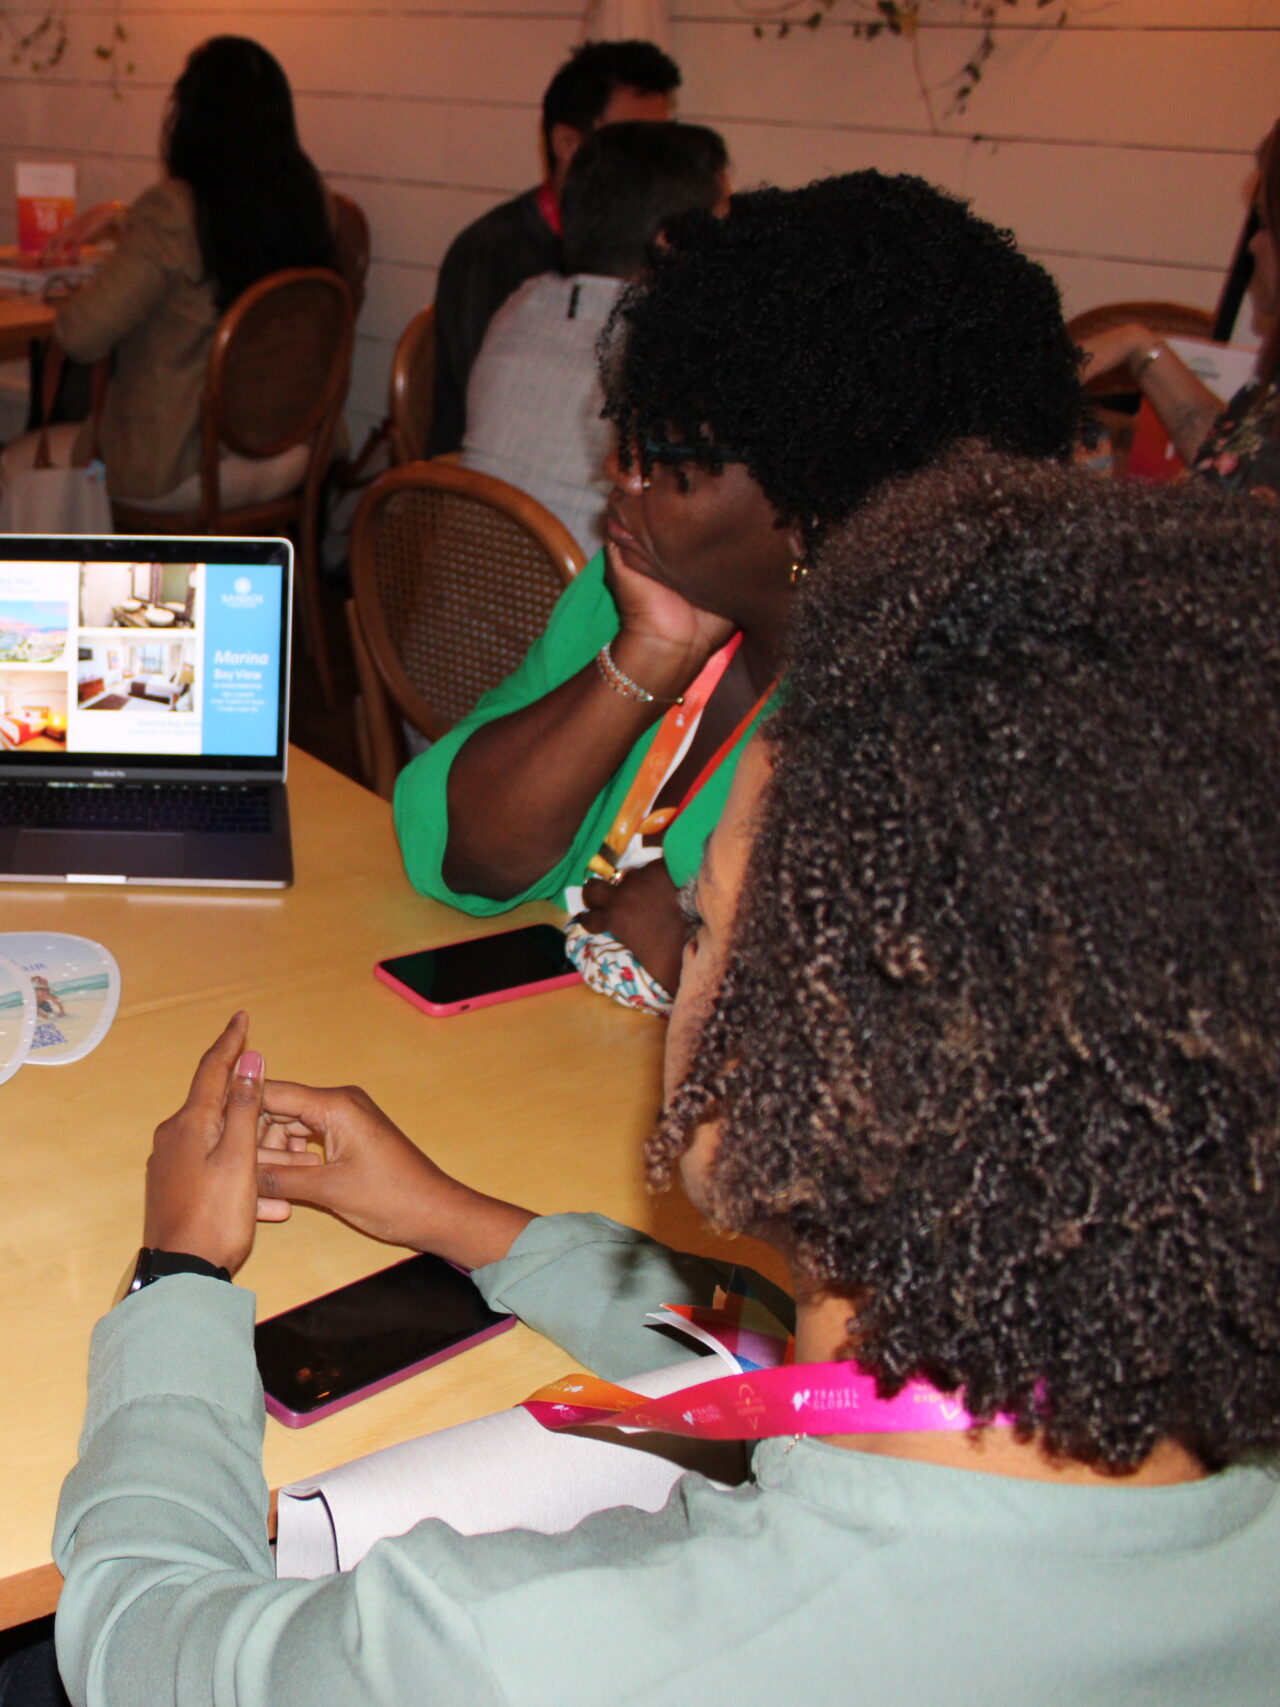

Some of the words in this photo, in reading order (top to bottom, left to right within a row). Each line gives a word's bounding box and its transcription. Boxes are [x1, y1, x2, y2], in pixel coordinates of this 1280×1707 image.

[214, 649, 270, 665] Marina
[214, 669, 234, 682] Bay
[235, 669, 263, 681] View
[813, 1389, 859, 1400] TRAVEL
[814, 1400, 860, 1411] GLOBAL
